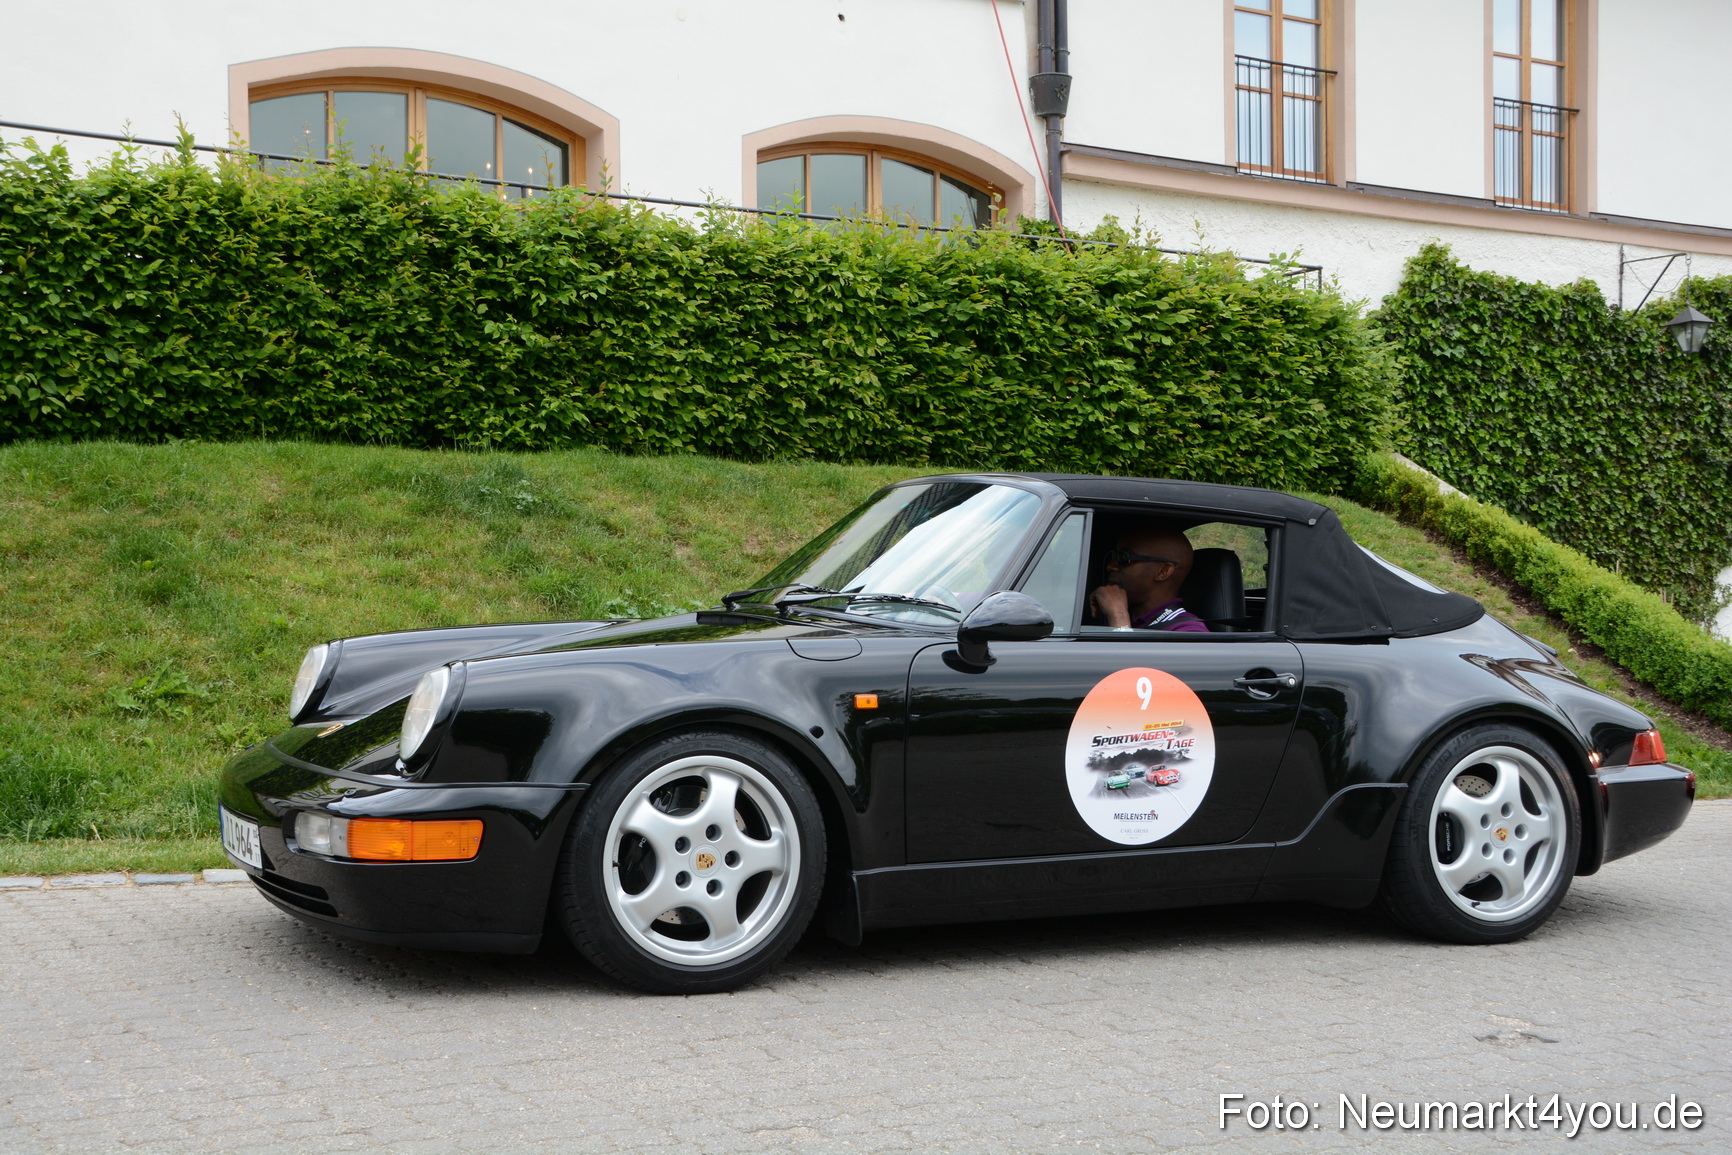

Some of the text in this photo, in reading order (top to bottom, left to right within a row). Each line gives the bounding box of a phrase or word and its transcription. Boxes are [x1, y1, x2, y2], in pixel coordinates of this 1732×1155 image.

[1136, 677, 1152, 711] 9
[1091, 730, 1174, 747] SPORTWAGEN-
[1166, 738, 1195, 750] TAGE
